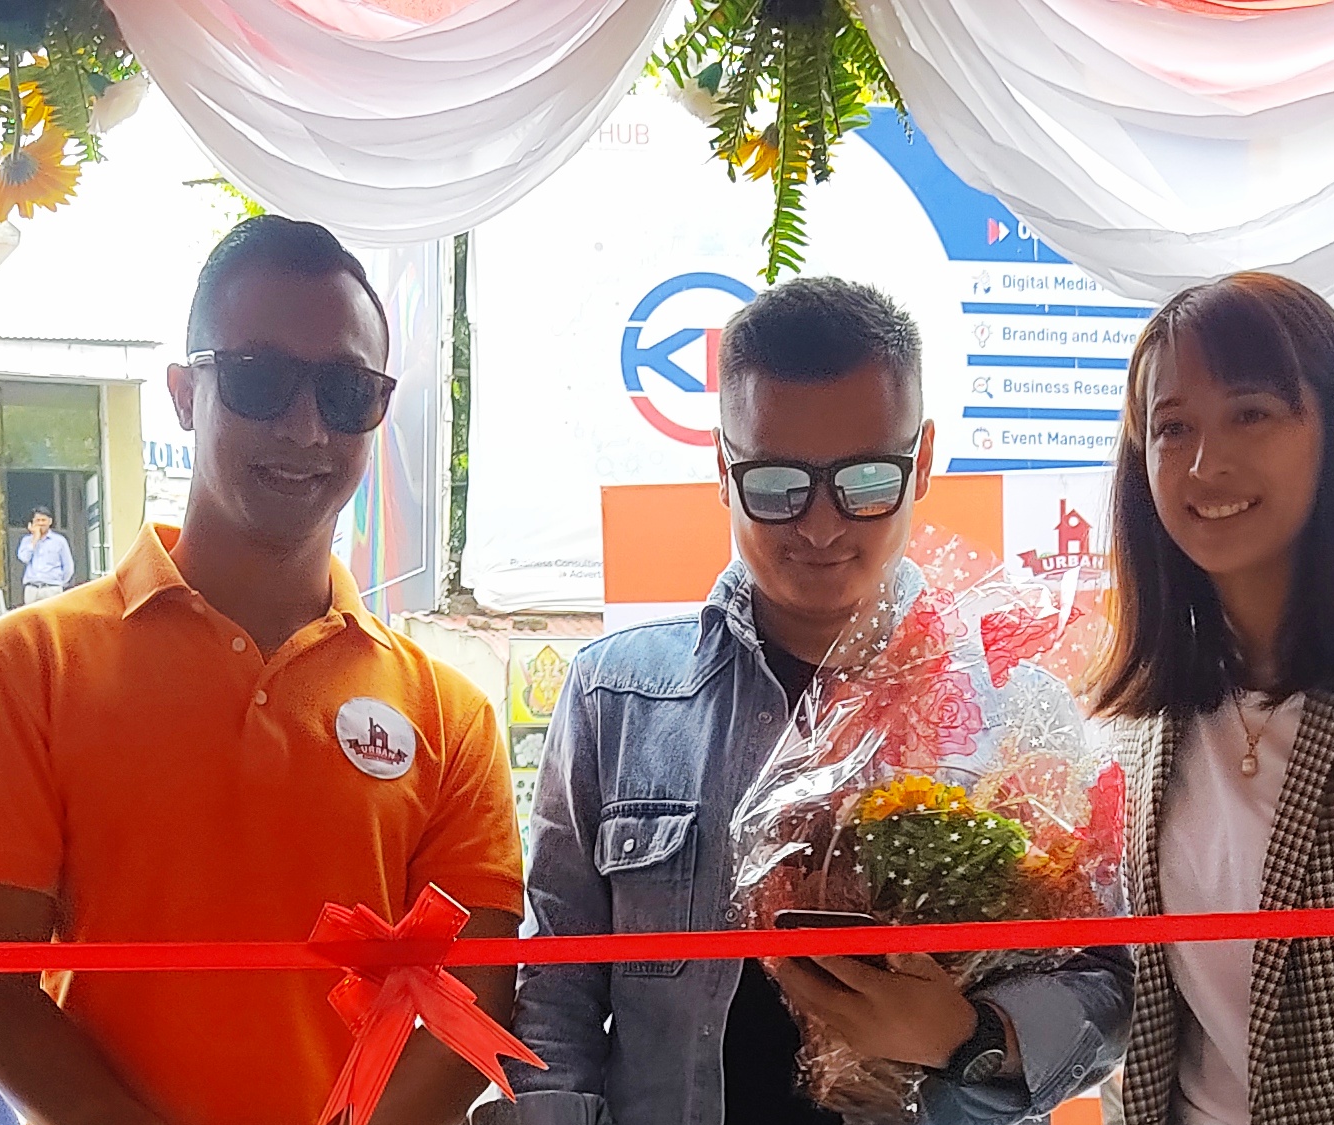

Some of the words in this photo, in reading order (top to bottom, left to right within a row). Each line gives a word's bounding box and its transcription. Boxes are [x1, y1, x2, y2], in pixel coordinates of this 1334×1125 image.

[599, 123, 649, 145] HUB
[1002, 274, 1050, 292] Digital
[1054, 276, 1097, 292] Media
[1002, 326, 1068, 345] Branding
[1071, 329, 1098, 344] and
[1101, 329, 1137, 345] Adve
[1003, 378, 1070, 394] Business
[1073, 380, 1125, 396] Resear
[1001, 430, 1043, 445] Event
[1047, 431, 1117, 450] Managem
[360, 744, 396, 760] URBAN
